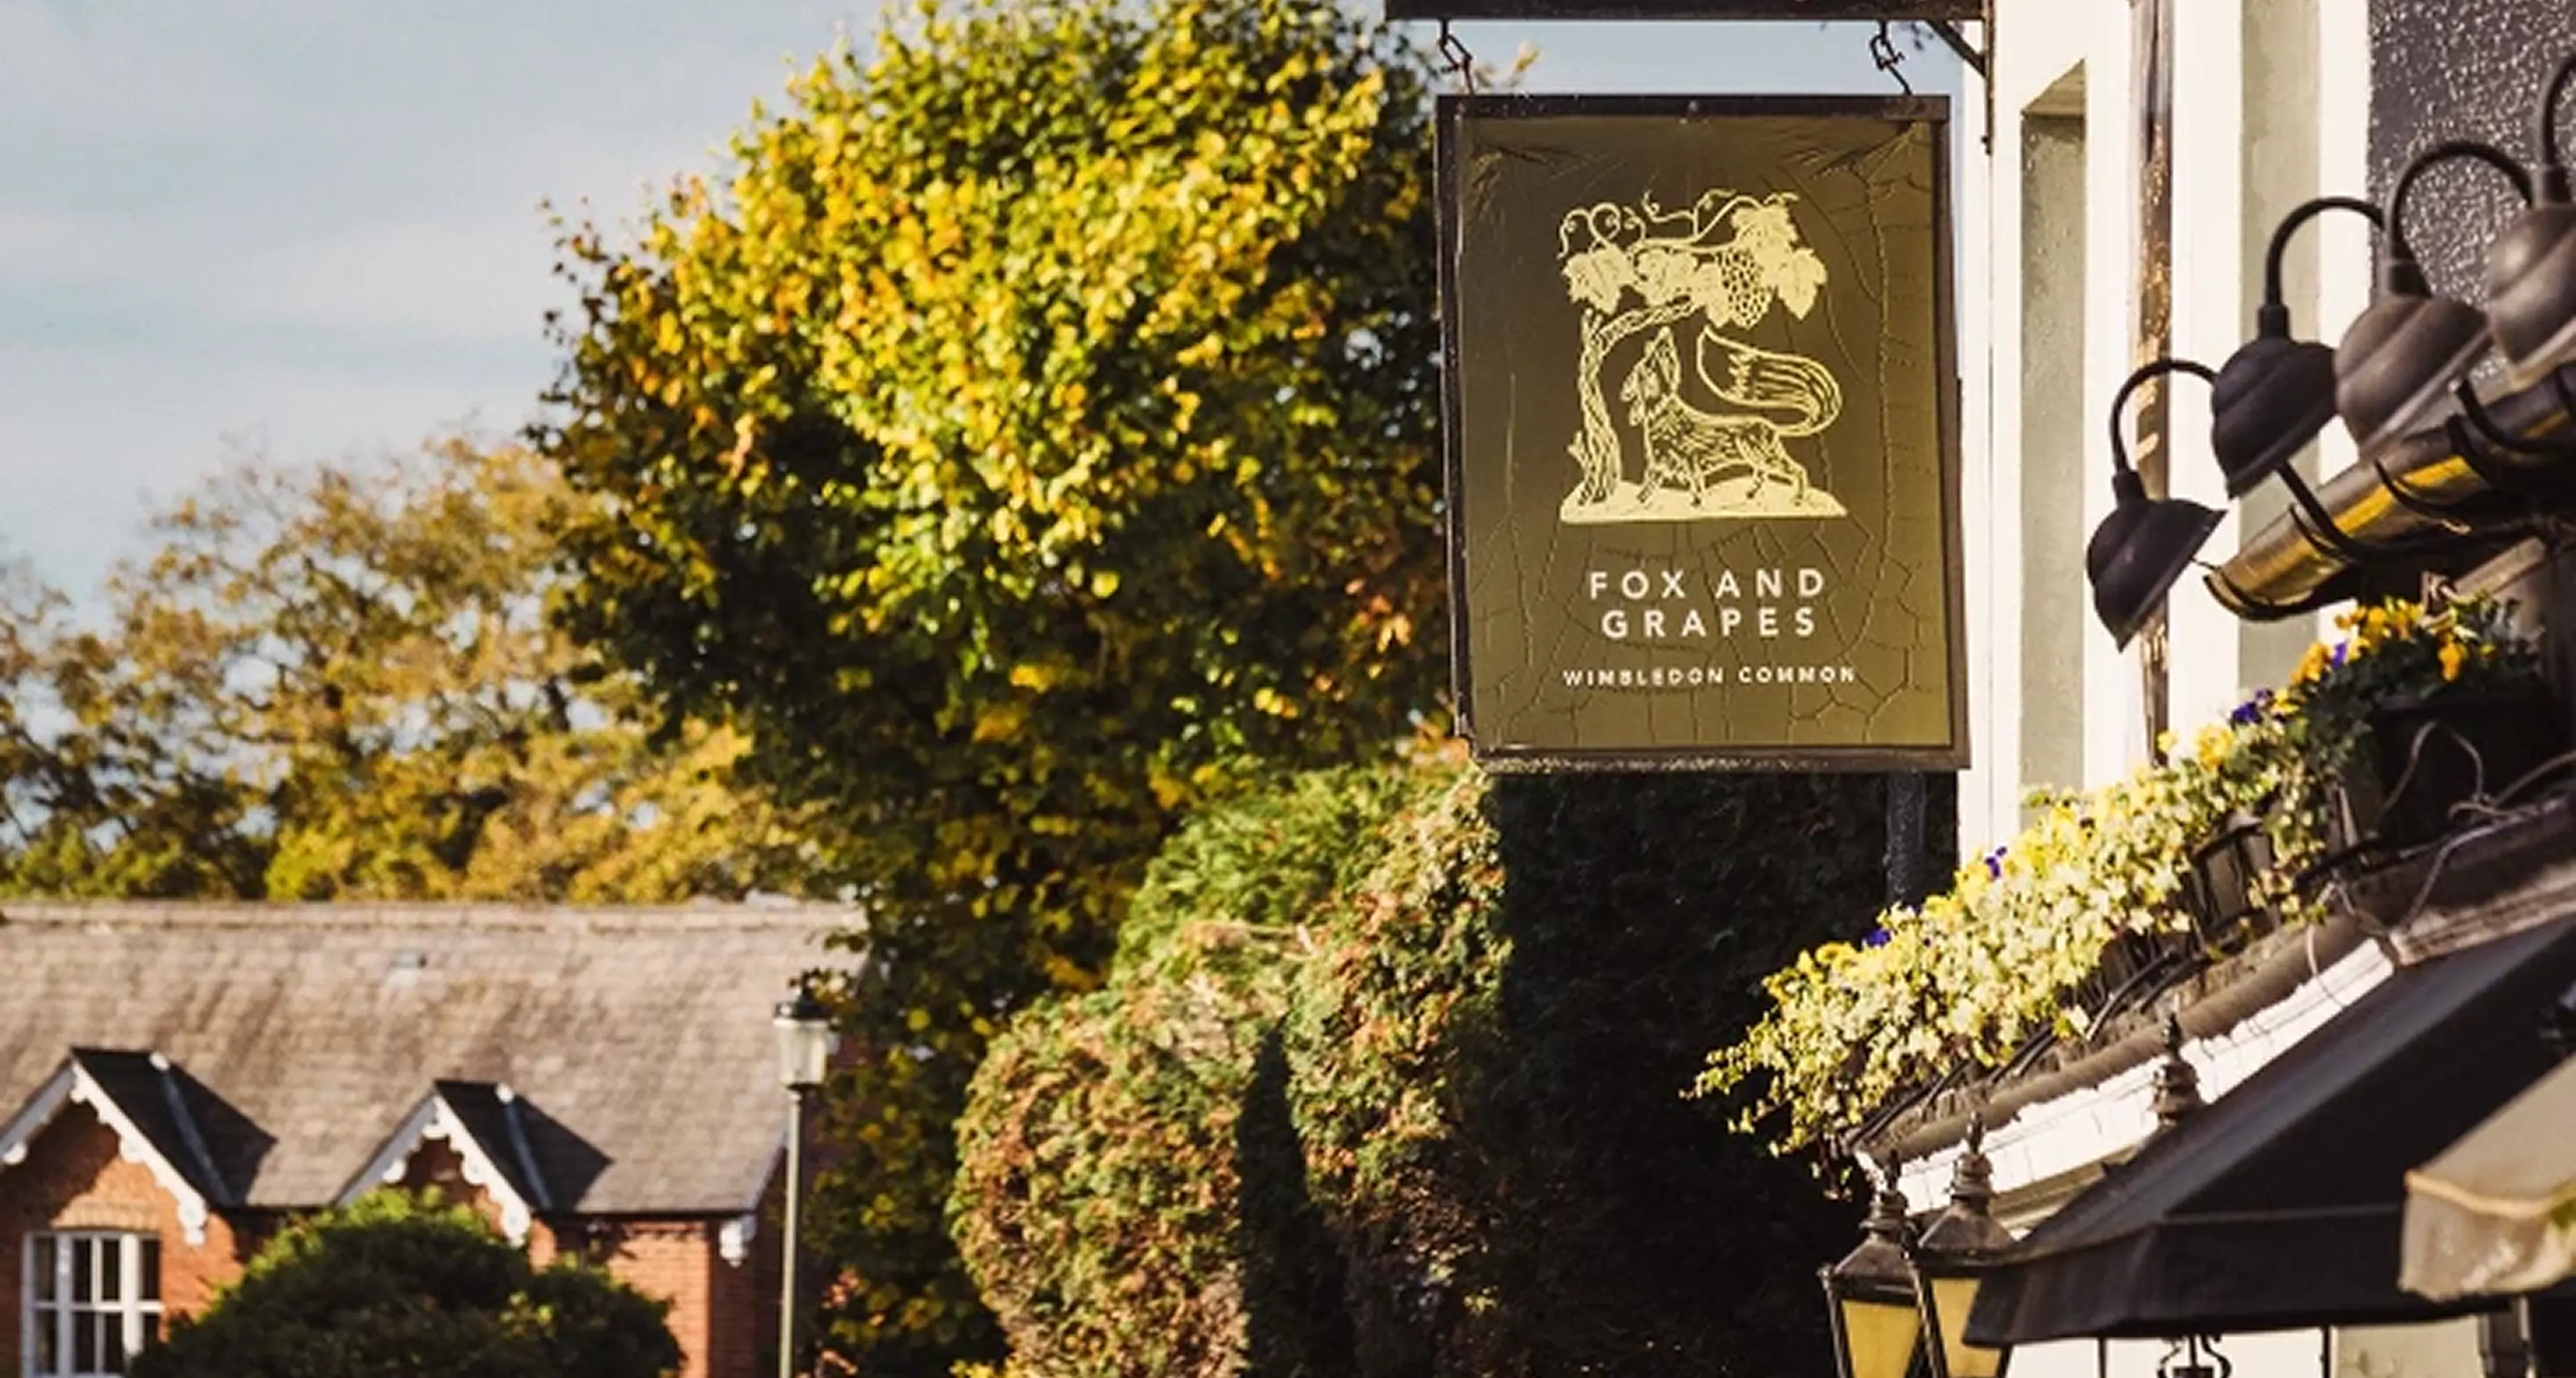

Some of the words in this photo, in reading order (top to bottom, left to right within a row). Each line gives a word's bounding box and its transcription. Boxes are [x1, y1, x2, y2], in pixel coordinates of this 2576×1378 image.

[1590, 570, 1685, 599] FOX
[1715, 569, 1823, 598] AND
[1602, 607, 1814, 639] GRAPES
[1563, 668, 1722, 686] WIMBLEDON
[1738, 666, 1854, 683] COMMON
